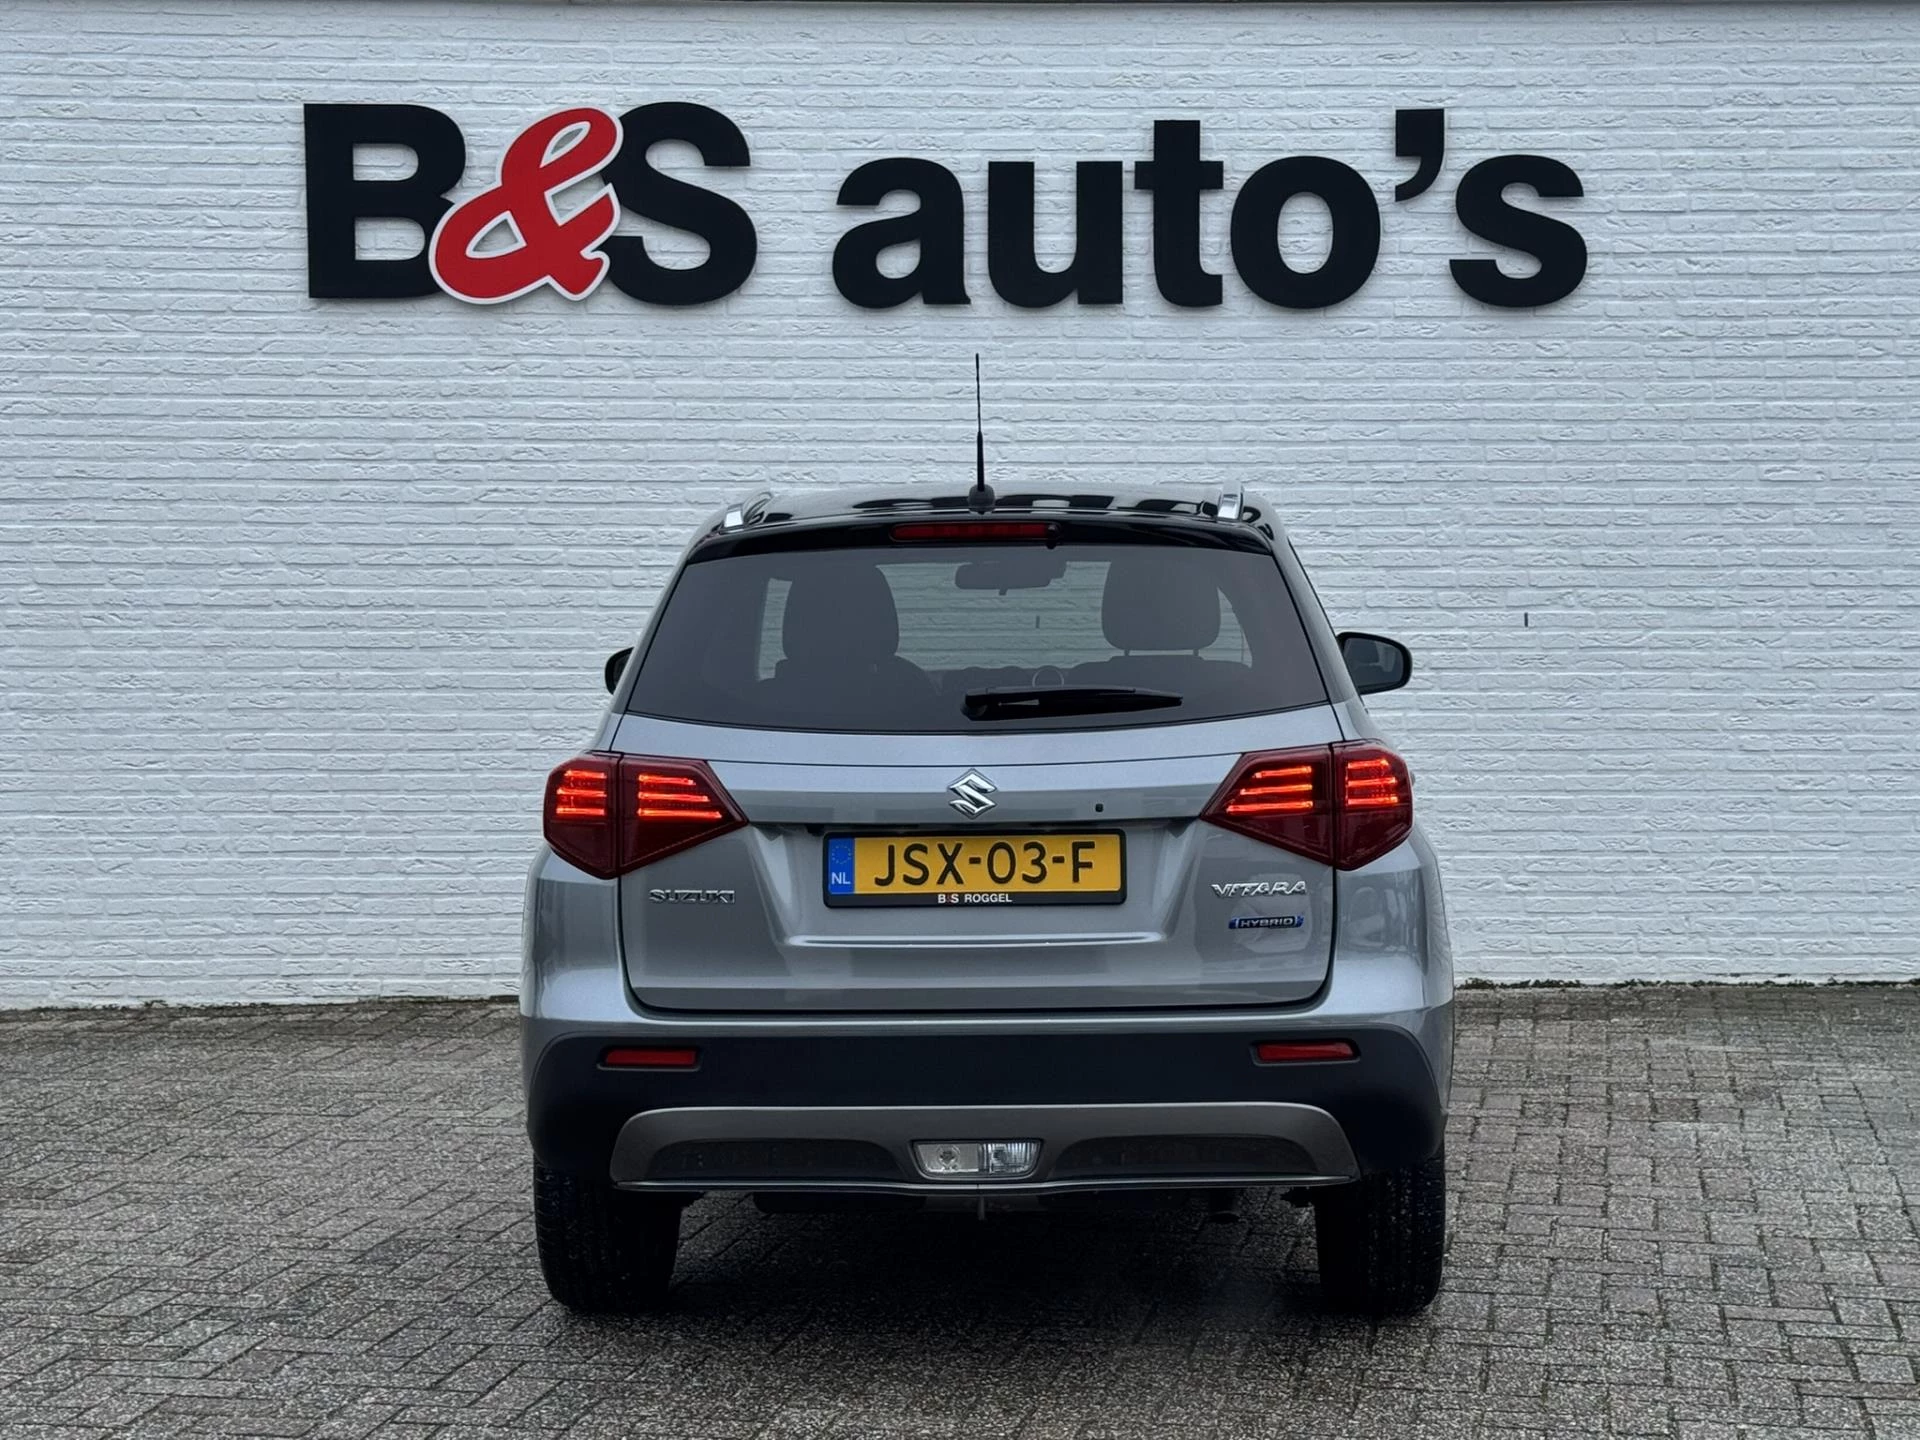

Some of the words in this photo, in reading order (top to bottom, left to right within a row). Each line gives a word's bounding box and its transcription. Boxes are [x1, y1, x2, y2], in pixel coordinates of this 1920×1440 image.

[304, 102, 757, 306] B&S
[874, 841, 1096, 887] JSX-03-F
[831, 872, 850, 885] NL
[648, 888, 735, 904] SUZUKI
[1210, 880, 1307, 898] VITARA
[963, 892, 1013, 904] ROGGEL
[1240, 917, 1295, 928] HYBRID
